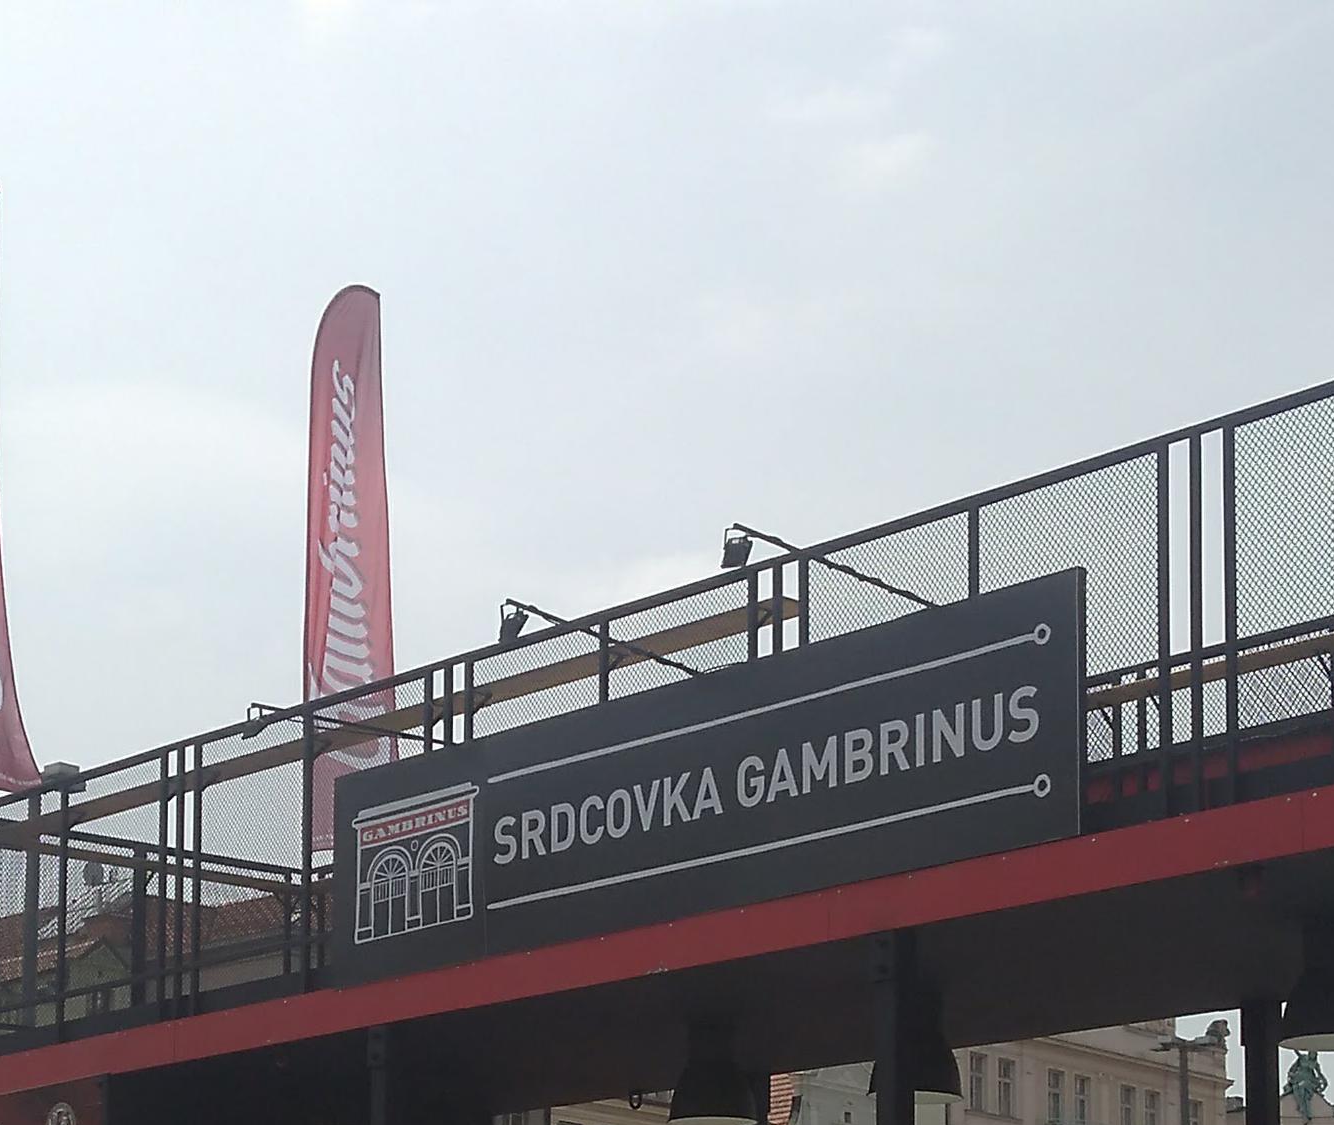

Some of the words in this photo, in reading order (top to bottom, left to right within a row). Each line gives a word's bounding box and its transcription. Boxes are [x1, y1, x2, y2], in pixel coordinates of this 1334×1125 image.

[362, 804, 468, 842] GAMBRINUS
[492, 766, 722, 866] SRDCOVKA
[735, 684, 1041, 810] GAMBRINUS
